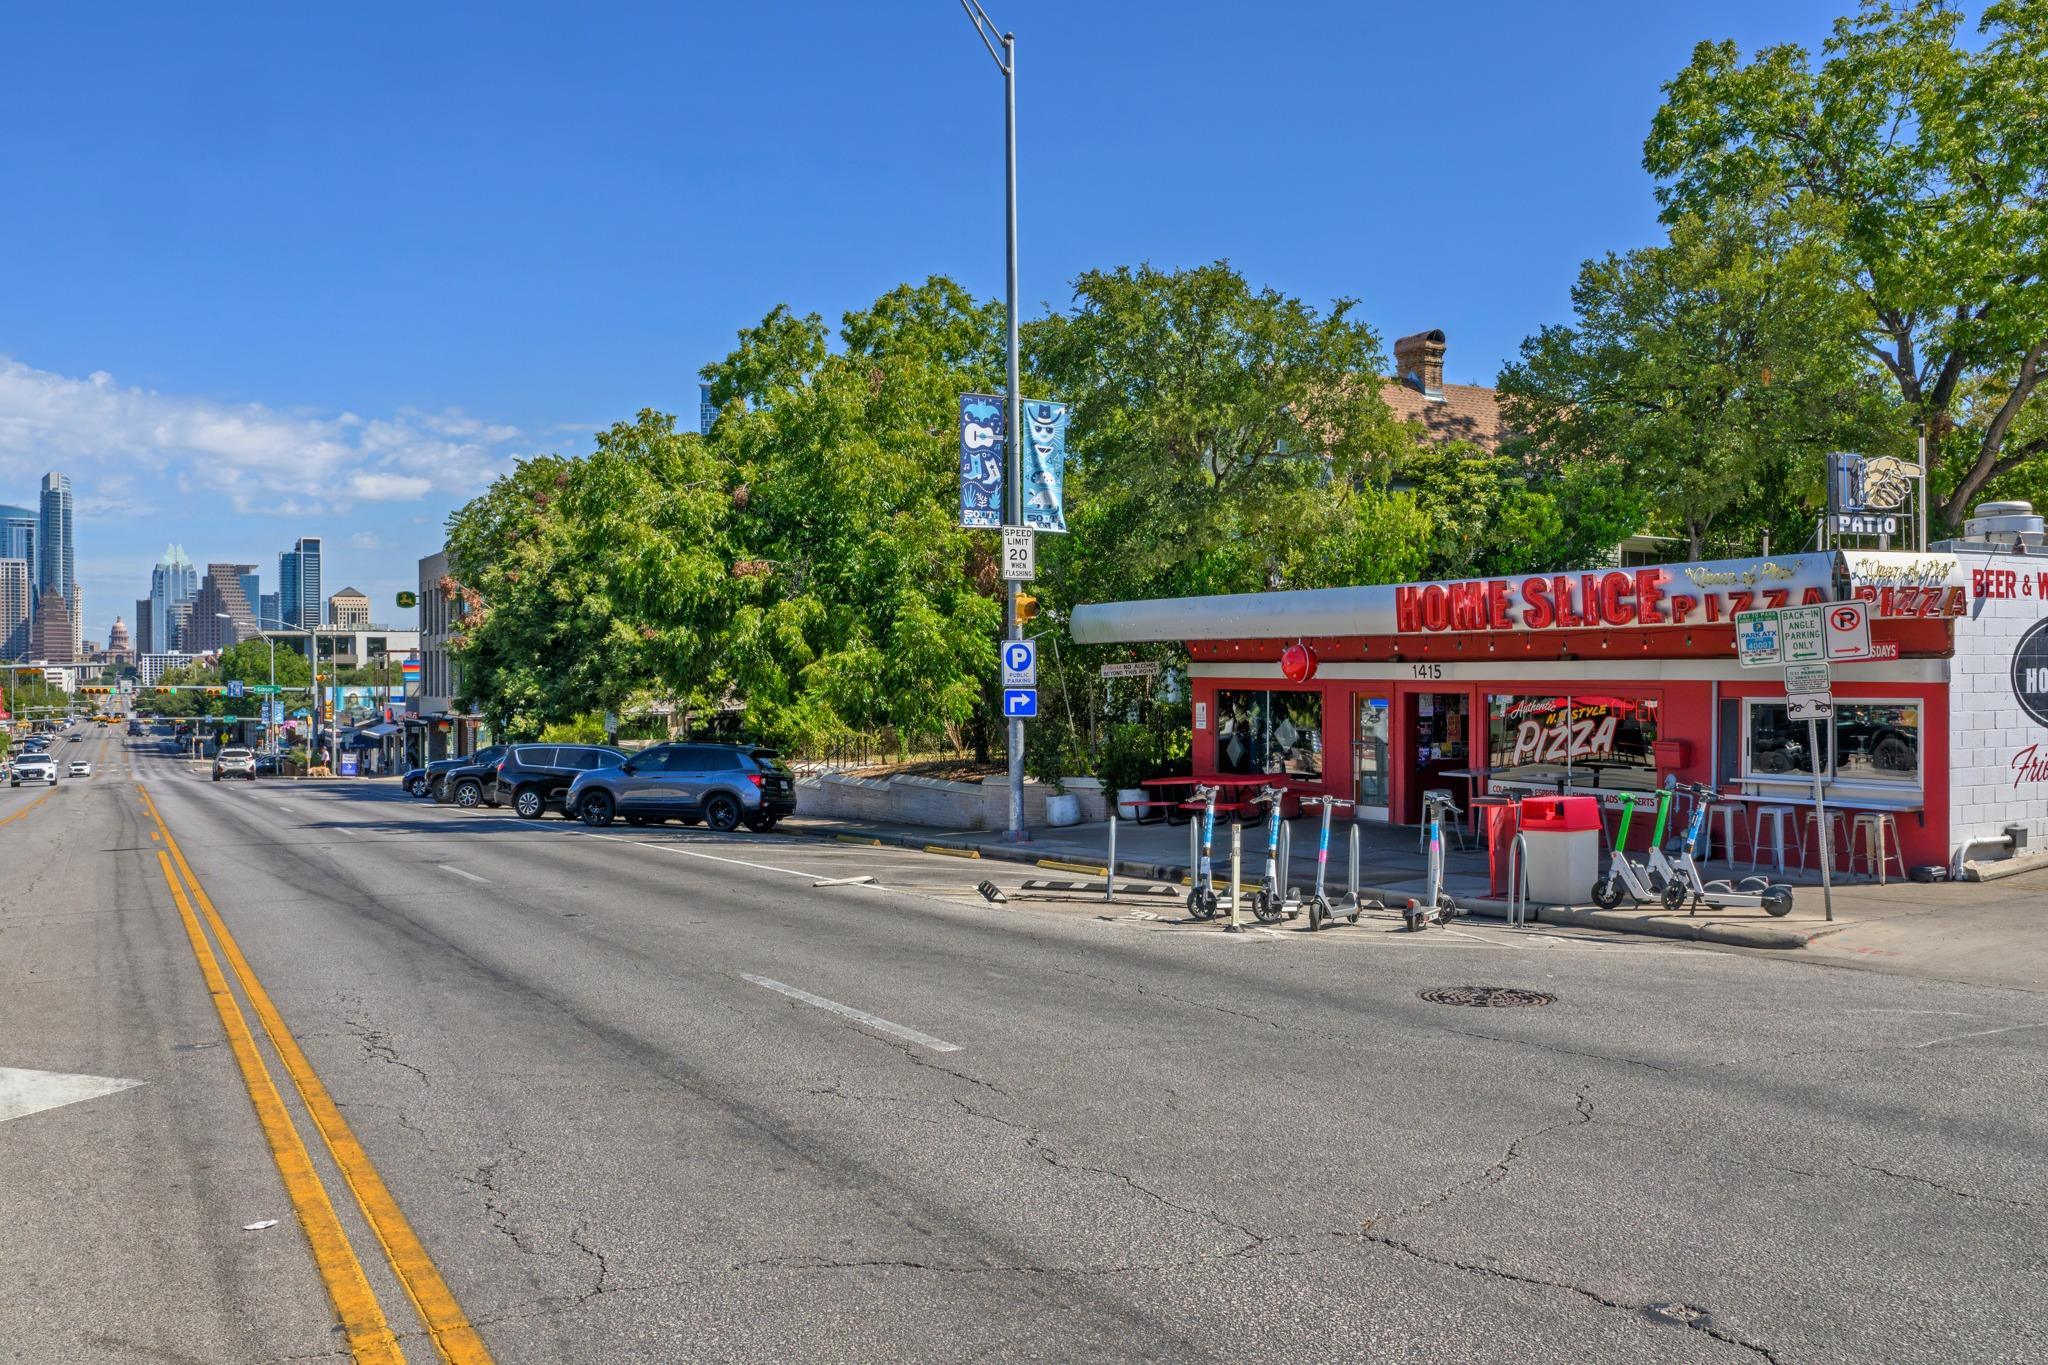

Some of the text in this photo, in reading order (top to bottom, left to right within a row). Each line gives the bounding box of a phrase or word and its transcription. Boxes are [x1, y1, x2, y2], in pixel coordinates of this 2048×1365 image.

[963, 510, 1000, 518] SOUTH
[1840, 516, 1896, 533] PATIO
[1004, 529, 1032, 537] SPEED
[1010, 548, 1028, 560] 20
[1972, 569, 2016, 598] BEER
[2022, 575, 2032, 596] &
[1395, 568, 1668, 632] HOME SLICE
[1671, 587, 1826, 624] PIZZA
[1855, 585, 1968, 617] PIZZA
[1783, 610, 1820, 620] BACK-IN
[1788, 620, 1815, 630] ANGLE
[1785, 630, 1820, 640] PARKING
[1792, 640, 1814, 650] ONLY
[1412, 664, 1442, 679] 1415
[1511, 700, 1556, 719] Authentic
[1572, 704, 1608, 720] STYLE
[1612, 700, 1658, 721] OPEN
[1513, 716, 1617, 766] PIZZA
